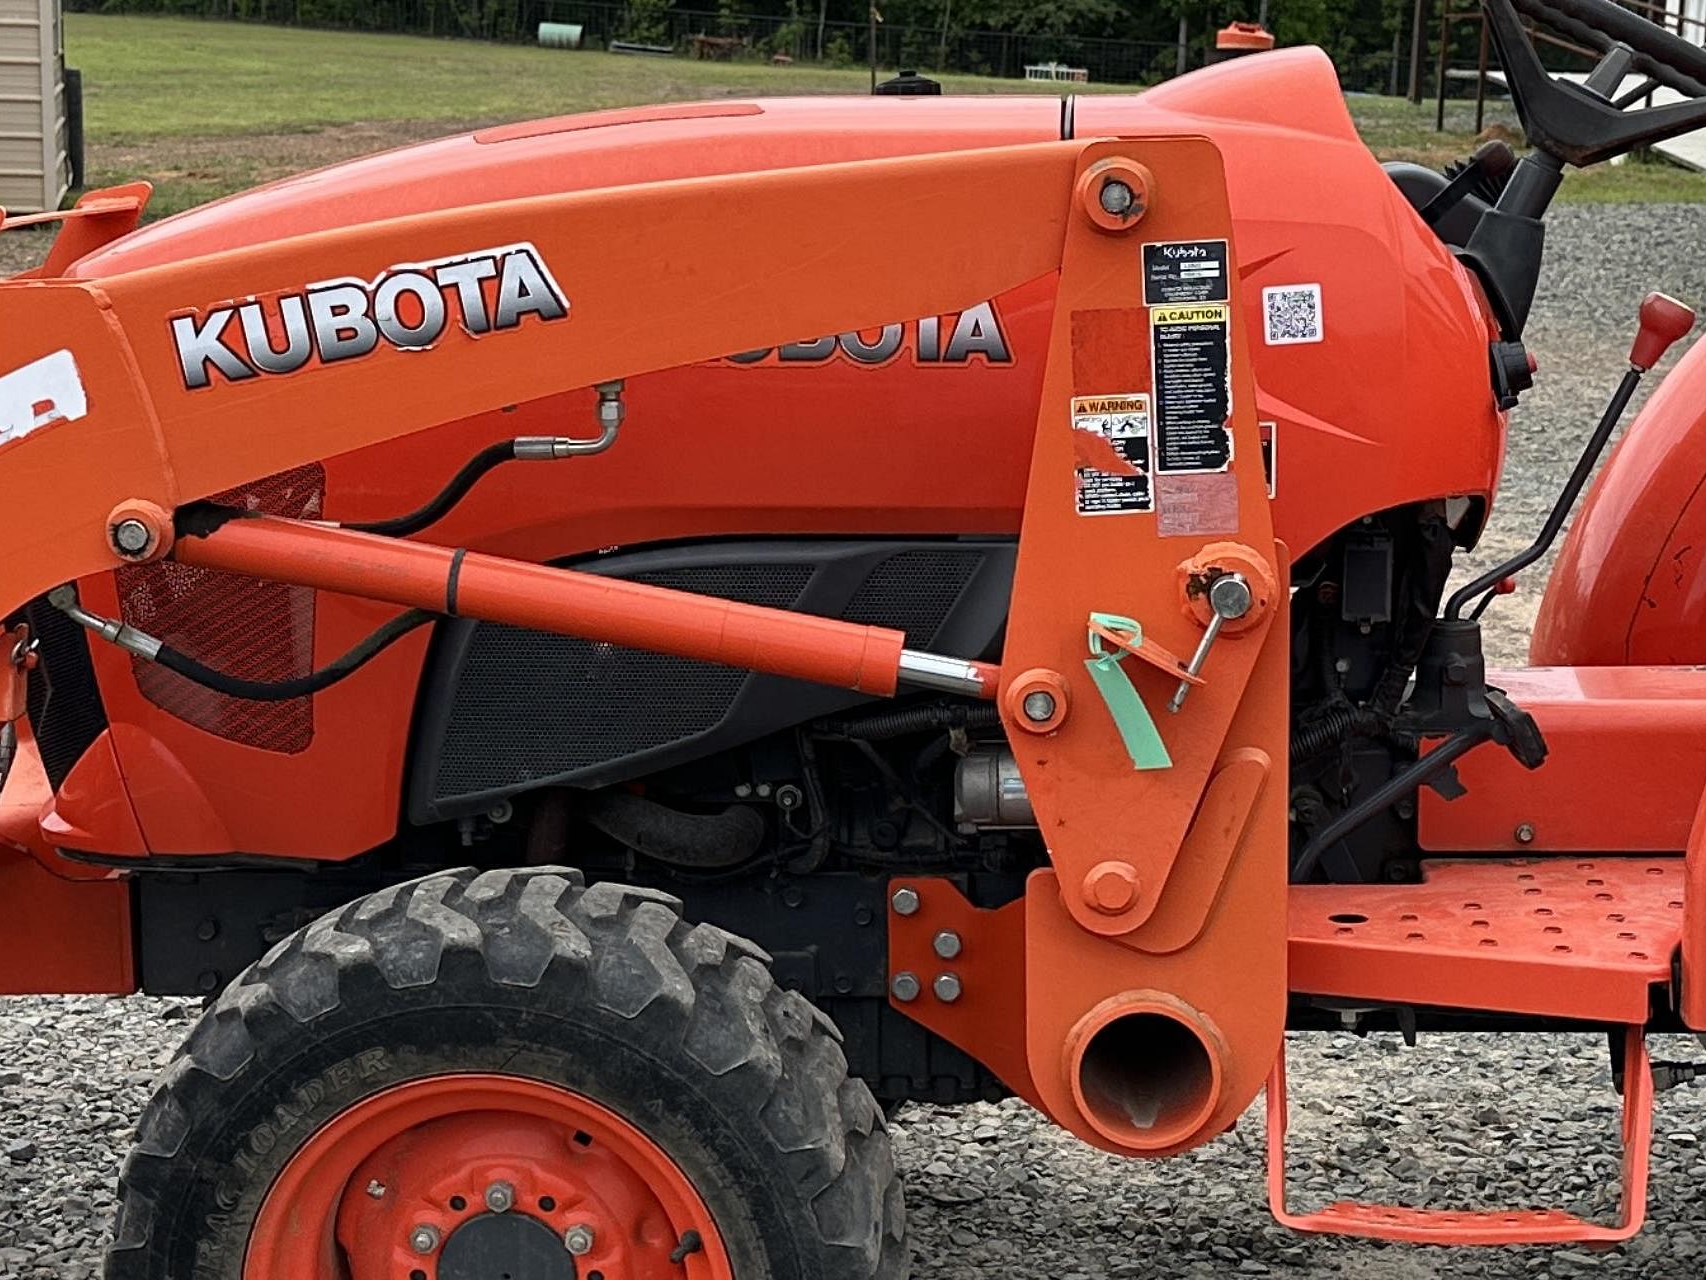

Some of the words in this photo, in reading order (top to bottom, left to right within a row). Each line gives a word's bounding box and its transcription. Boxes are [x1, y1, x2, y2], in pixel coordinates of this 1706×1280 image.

[1163, 246, 1207, 259] Kubota
[170, 248, 570, 391] KUBOTA
[1169, 309, 1223, 321] CAUTION
[1089, 400, 1143, 412] WARNING
